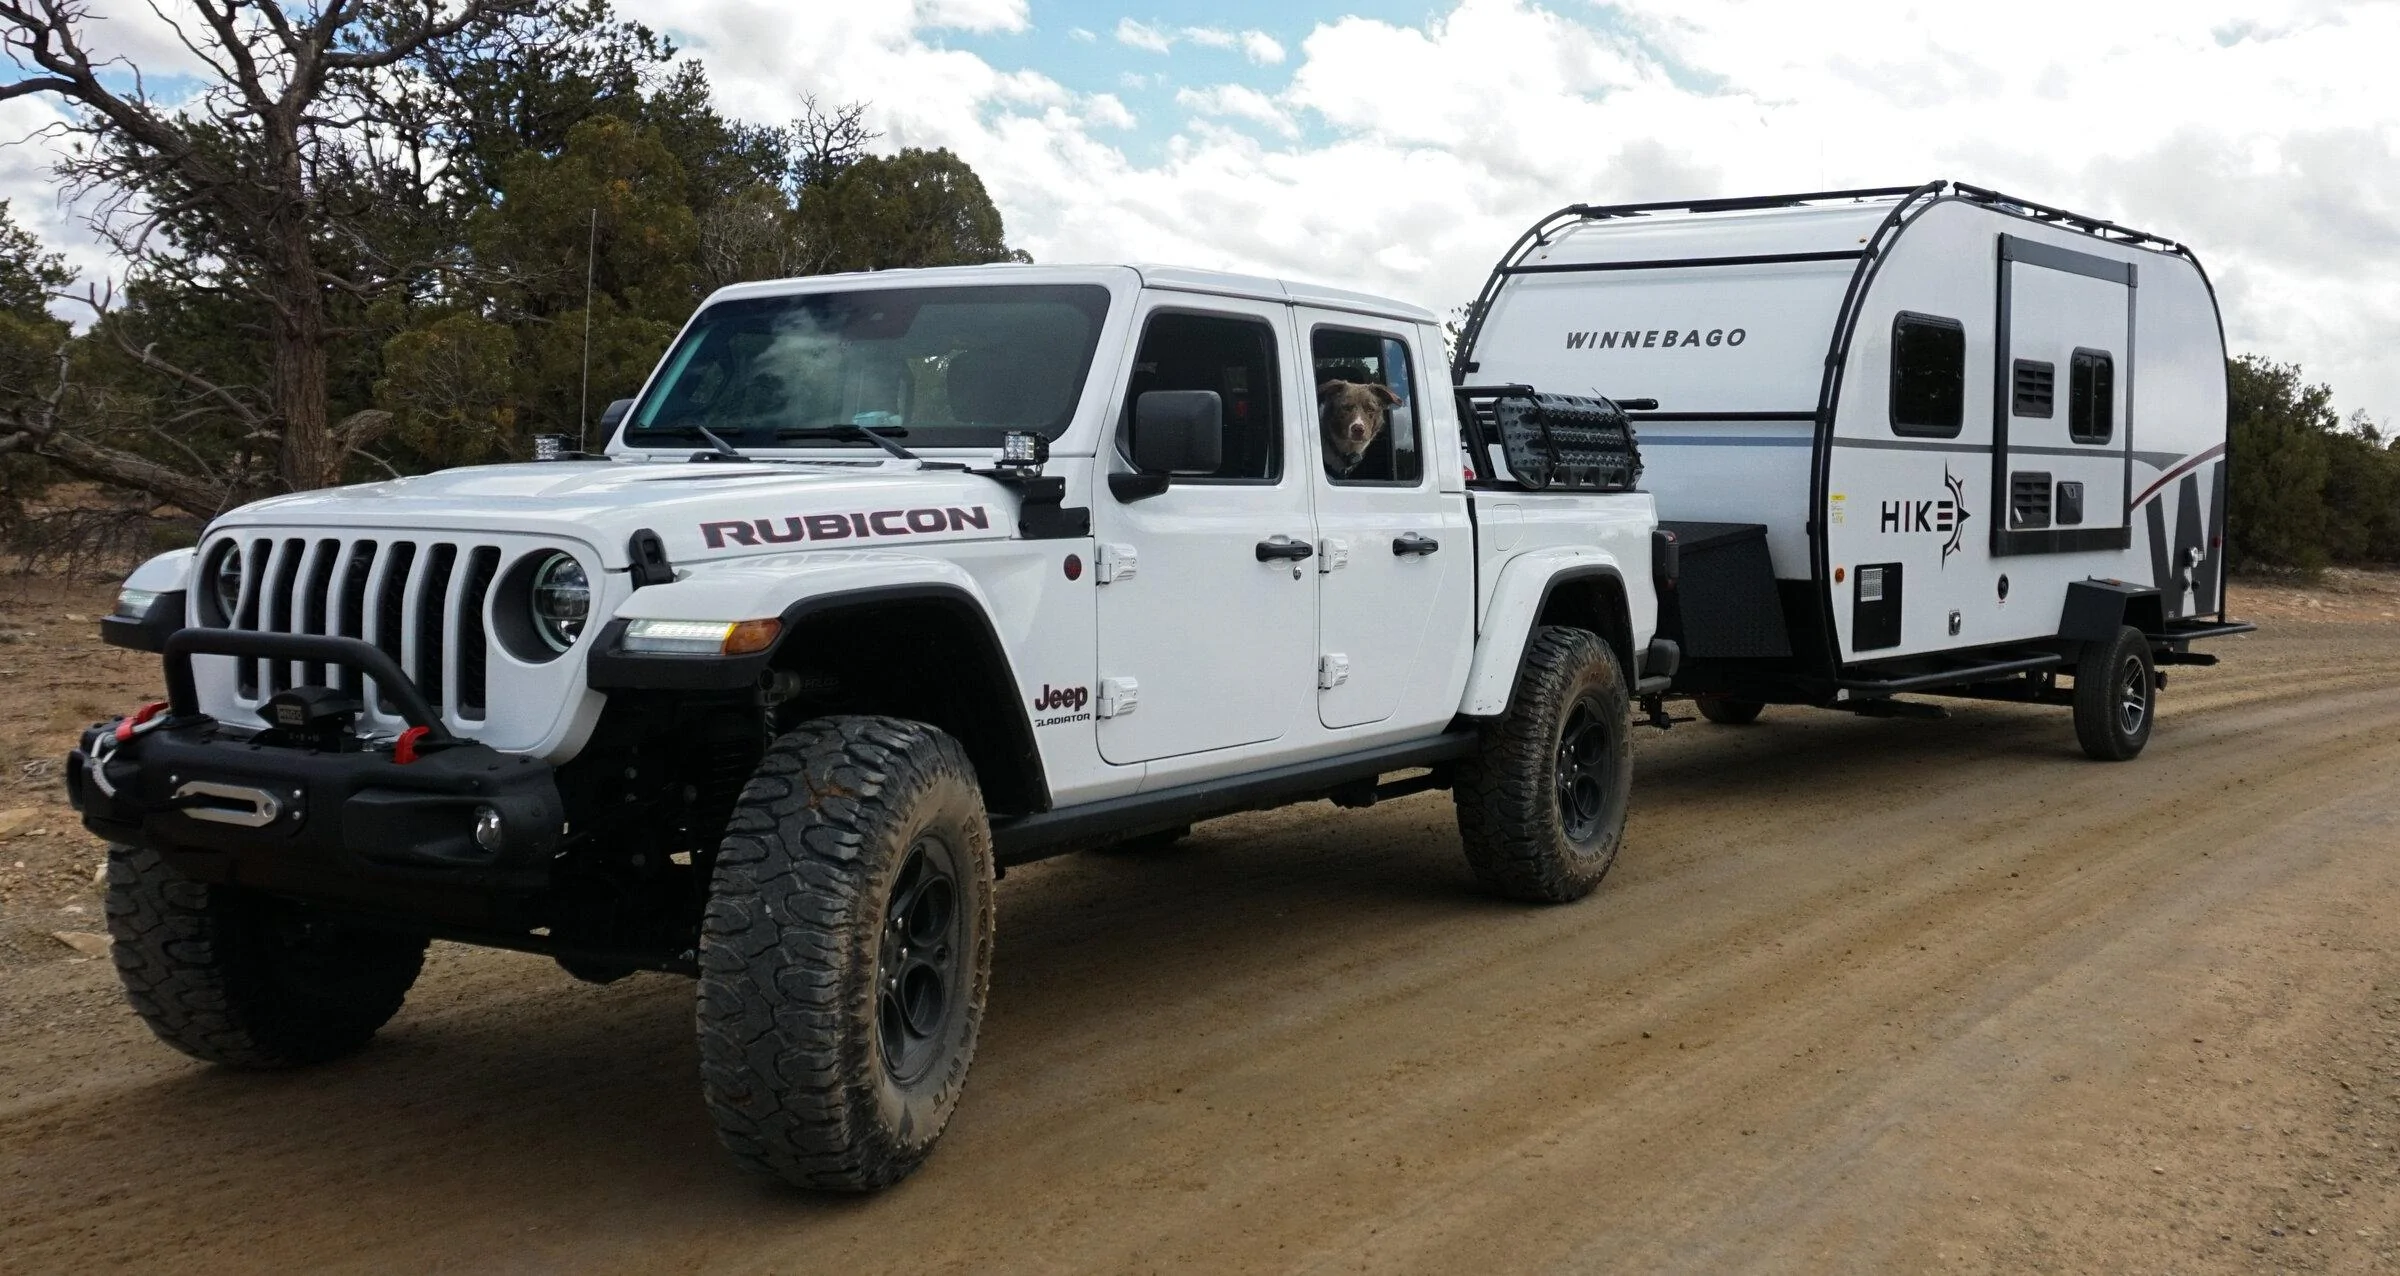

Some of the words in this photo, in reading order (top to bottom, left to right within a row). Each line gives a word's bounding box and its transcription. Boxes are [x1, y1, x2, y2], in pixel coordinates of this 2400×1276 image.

[1566, 328, 1746, 349] WINNEBAGO
[699, 506, 989, 549] RUBICON
[1881, 500, 1954, 533] HIKE
[1035, 684, 1088, 712] Jeep
[1035, 713, 1091, 728] GLADIATOR
